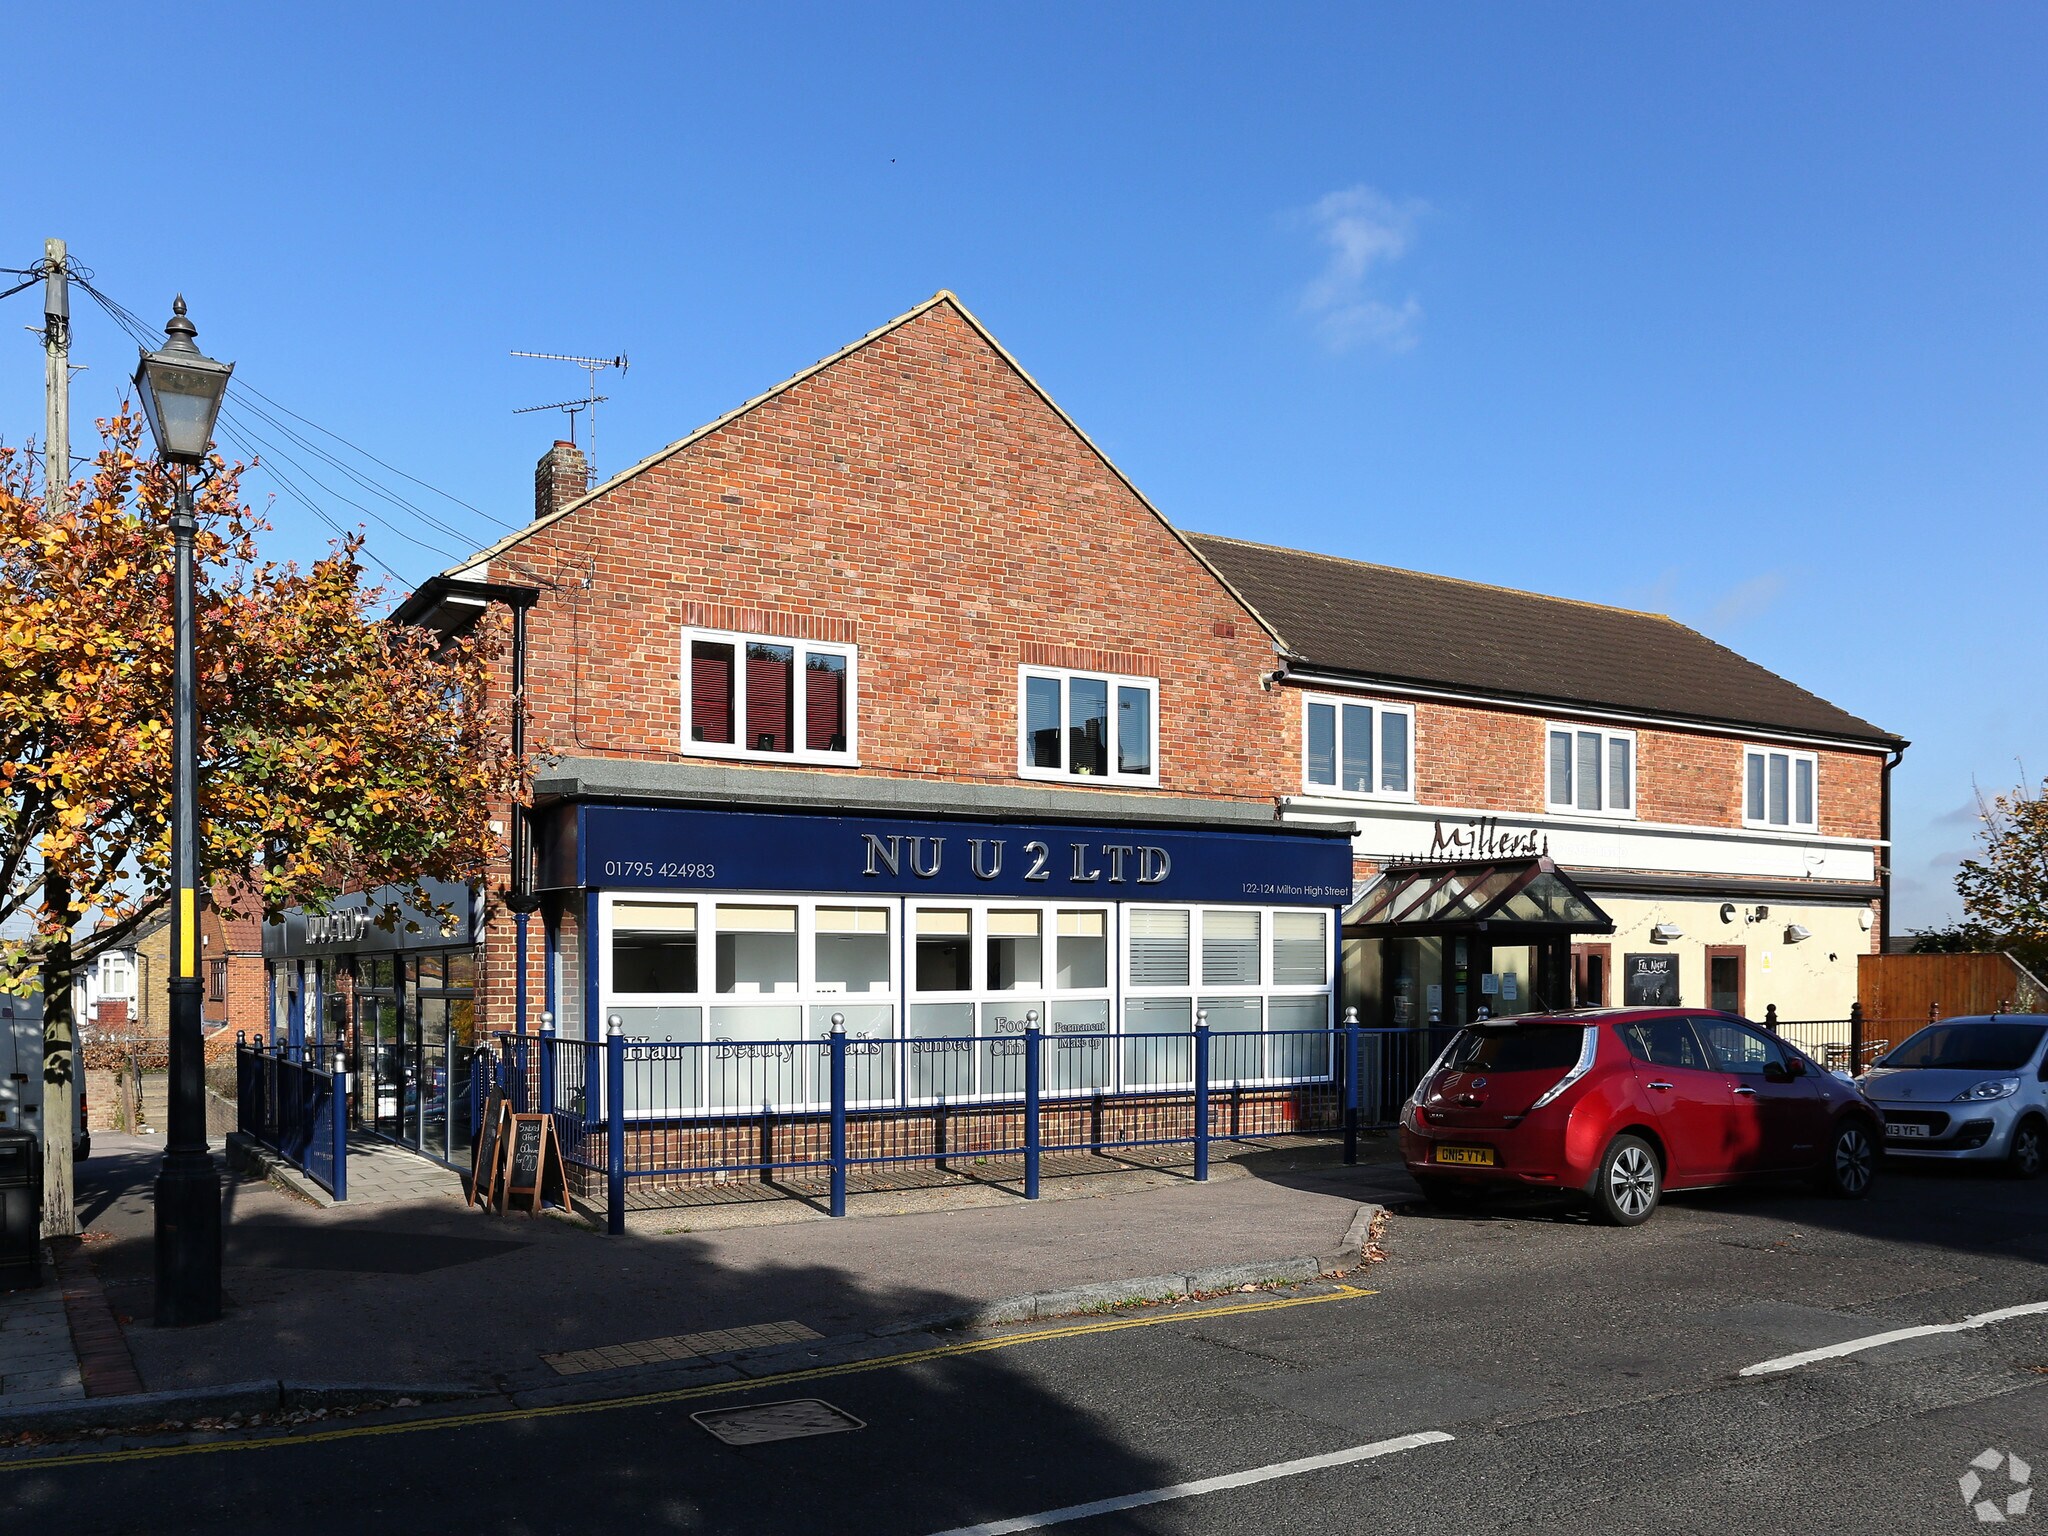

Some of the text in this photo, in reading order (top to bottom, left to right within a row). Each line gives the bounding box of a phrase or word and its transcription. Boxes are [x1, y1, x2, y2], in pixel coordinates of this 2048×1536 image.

[1430, 816, 1538, 856] Millers
[861, 833, 1172, 883] NU U 2 LTD
[605, 861, 715, 878] 01795 424983
[1242, 883, 1348, 897] 122-124 Milton High Street
[995, 1017, 1028, 1033] Foo
[1055, 1021, 1105, 1033] Permanent
[624, 1035, 683, 1061] Hair
[716, 1037, 794, 1063] Beauty
[913, 1035, 972, 1053] Sunbed
[990, 1039, 1027, 1056] Clin
[1059, 1037, 1101, 1049] Make up
[1886, 1125, 1923, 1136] K13 YFL
[1467, 1150, 1487, 1162] VTA
